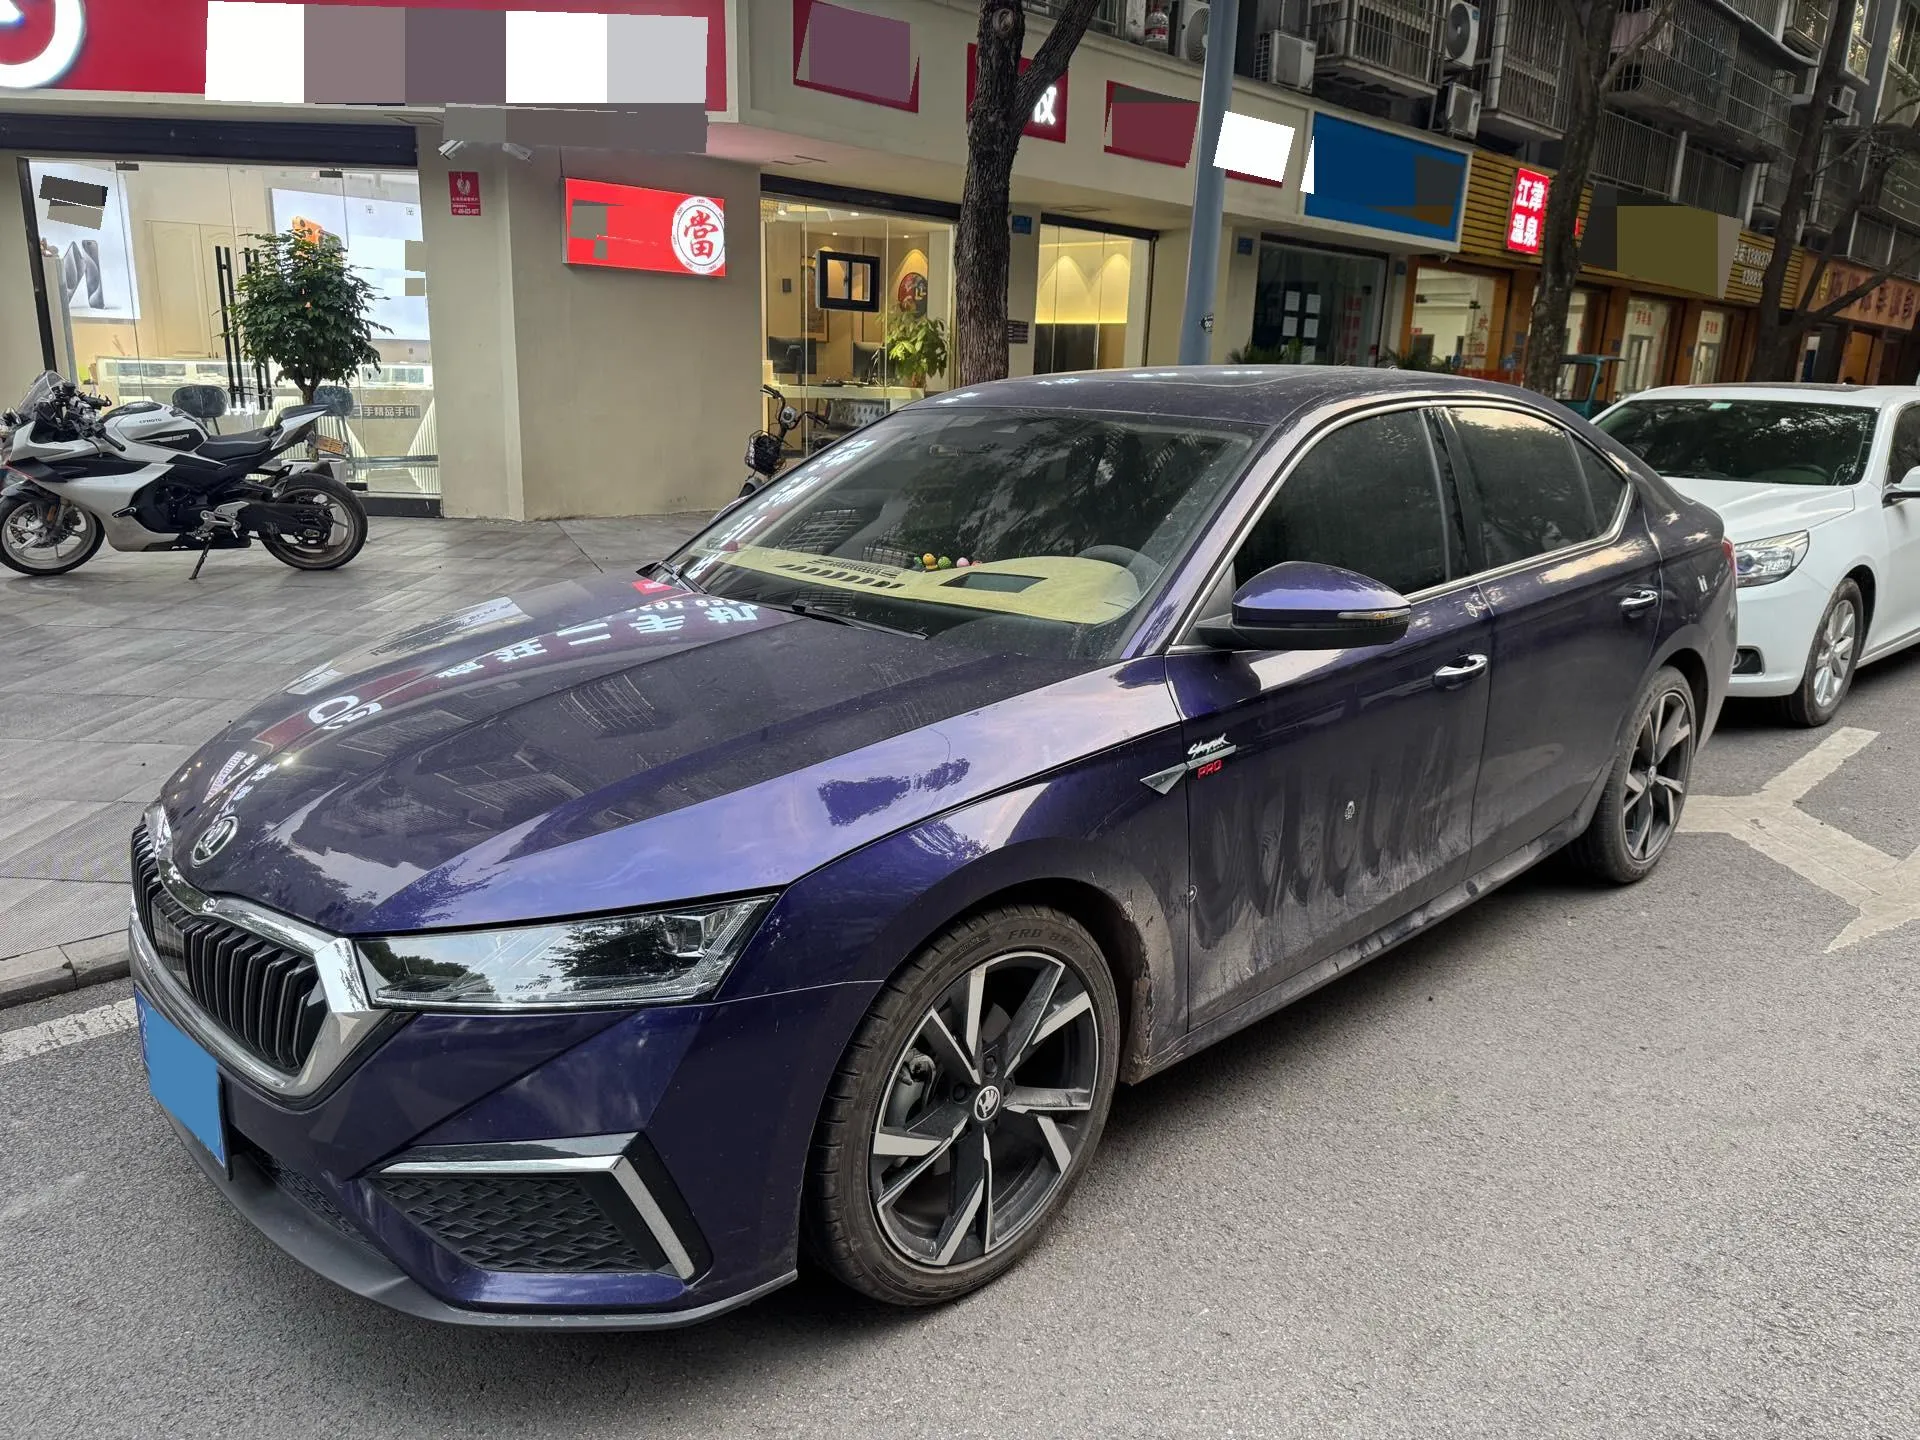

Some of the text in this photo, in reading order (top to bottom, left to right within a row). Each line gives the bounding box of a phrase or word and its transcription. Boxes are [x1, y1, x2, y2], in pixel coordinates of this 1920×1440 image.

[1515, 177, 1545, 212] 江津
[683, 209, 719, 259] 當
[1197, 759, 1223, 780] PRO
